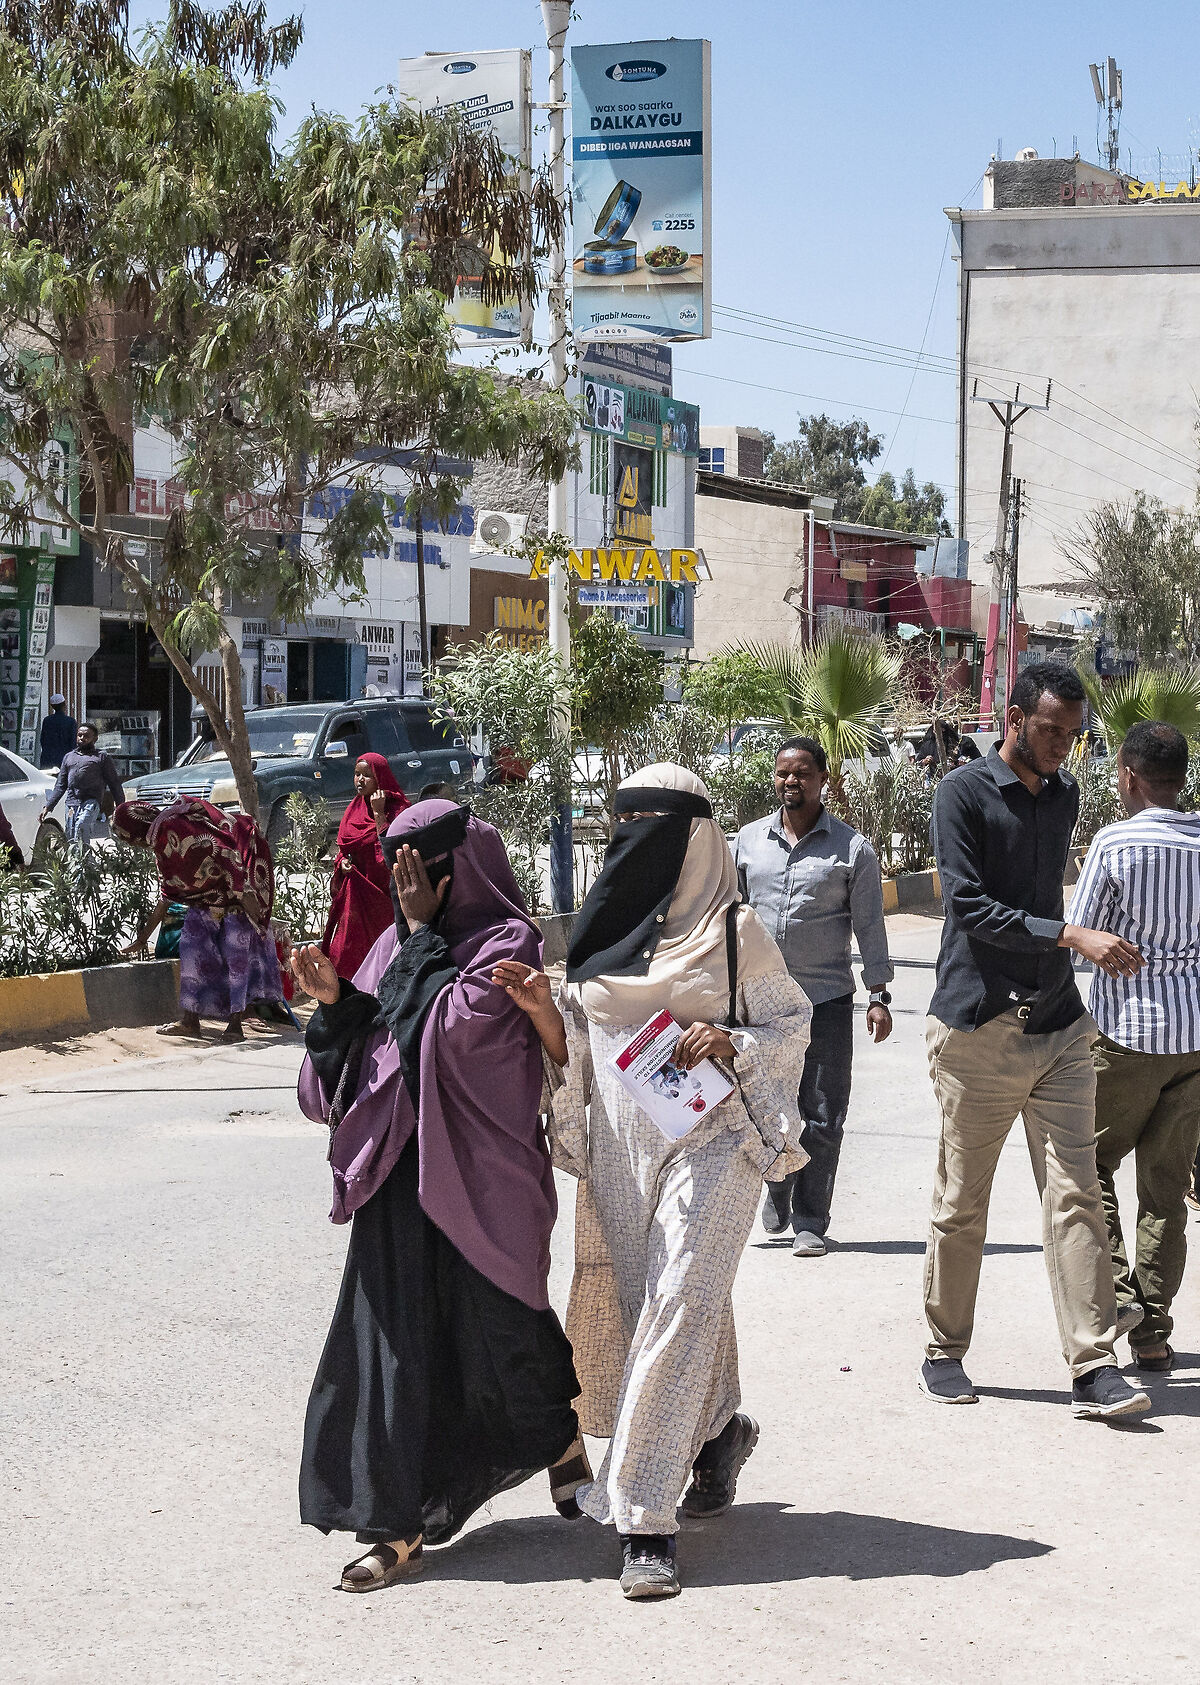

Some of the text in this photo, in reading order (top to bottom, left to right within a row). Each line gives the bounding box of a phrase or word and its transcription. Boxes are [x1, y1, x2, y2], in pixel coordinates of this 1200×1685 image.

[464, 96, 486, 108] Tuna
[488, 103, 511, 115] xumo
[596, 100, 673, 113] wax soo saarka
[590, 113, 682, 130] DALKAYGU
[580, 138, 691, 152] DIBED IIGA WANAAGSAN
[1060, 180, 1124, 200] DARA
[665, 220, 695, 230] 2255
[626, 391, 662, 425] ALJAMIL
[617, 510, 655, 541] LJAMIL
[580, 589, 647, 602] Phone & Accessories
[496, 596, 549, 631] NIMC
[242, 622, 267, 634] ANWAR
[362, 626, 394, 644] ANWAR
[405, 650, 421, 662] ANW
[649, 1045, 676, 1072] NTRODUCTION
